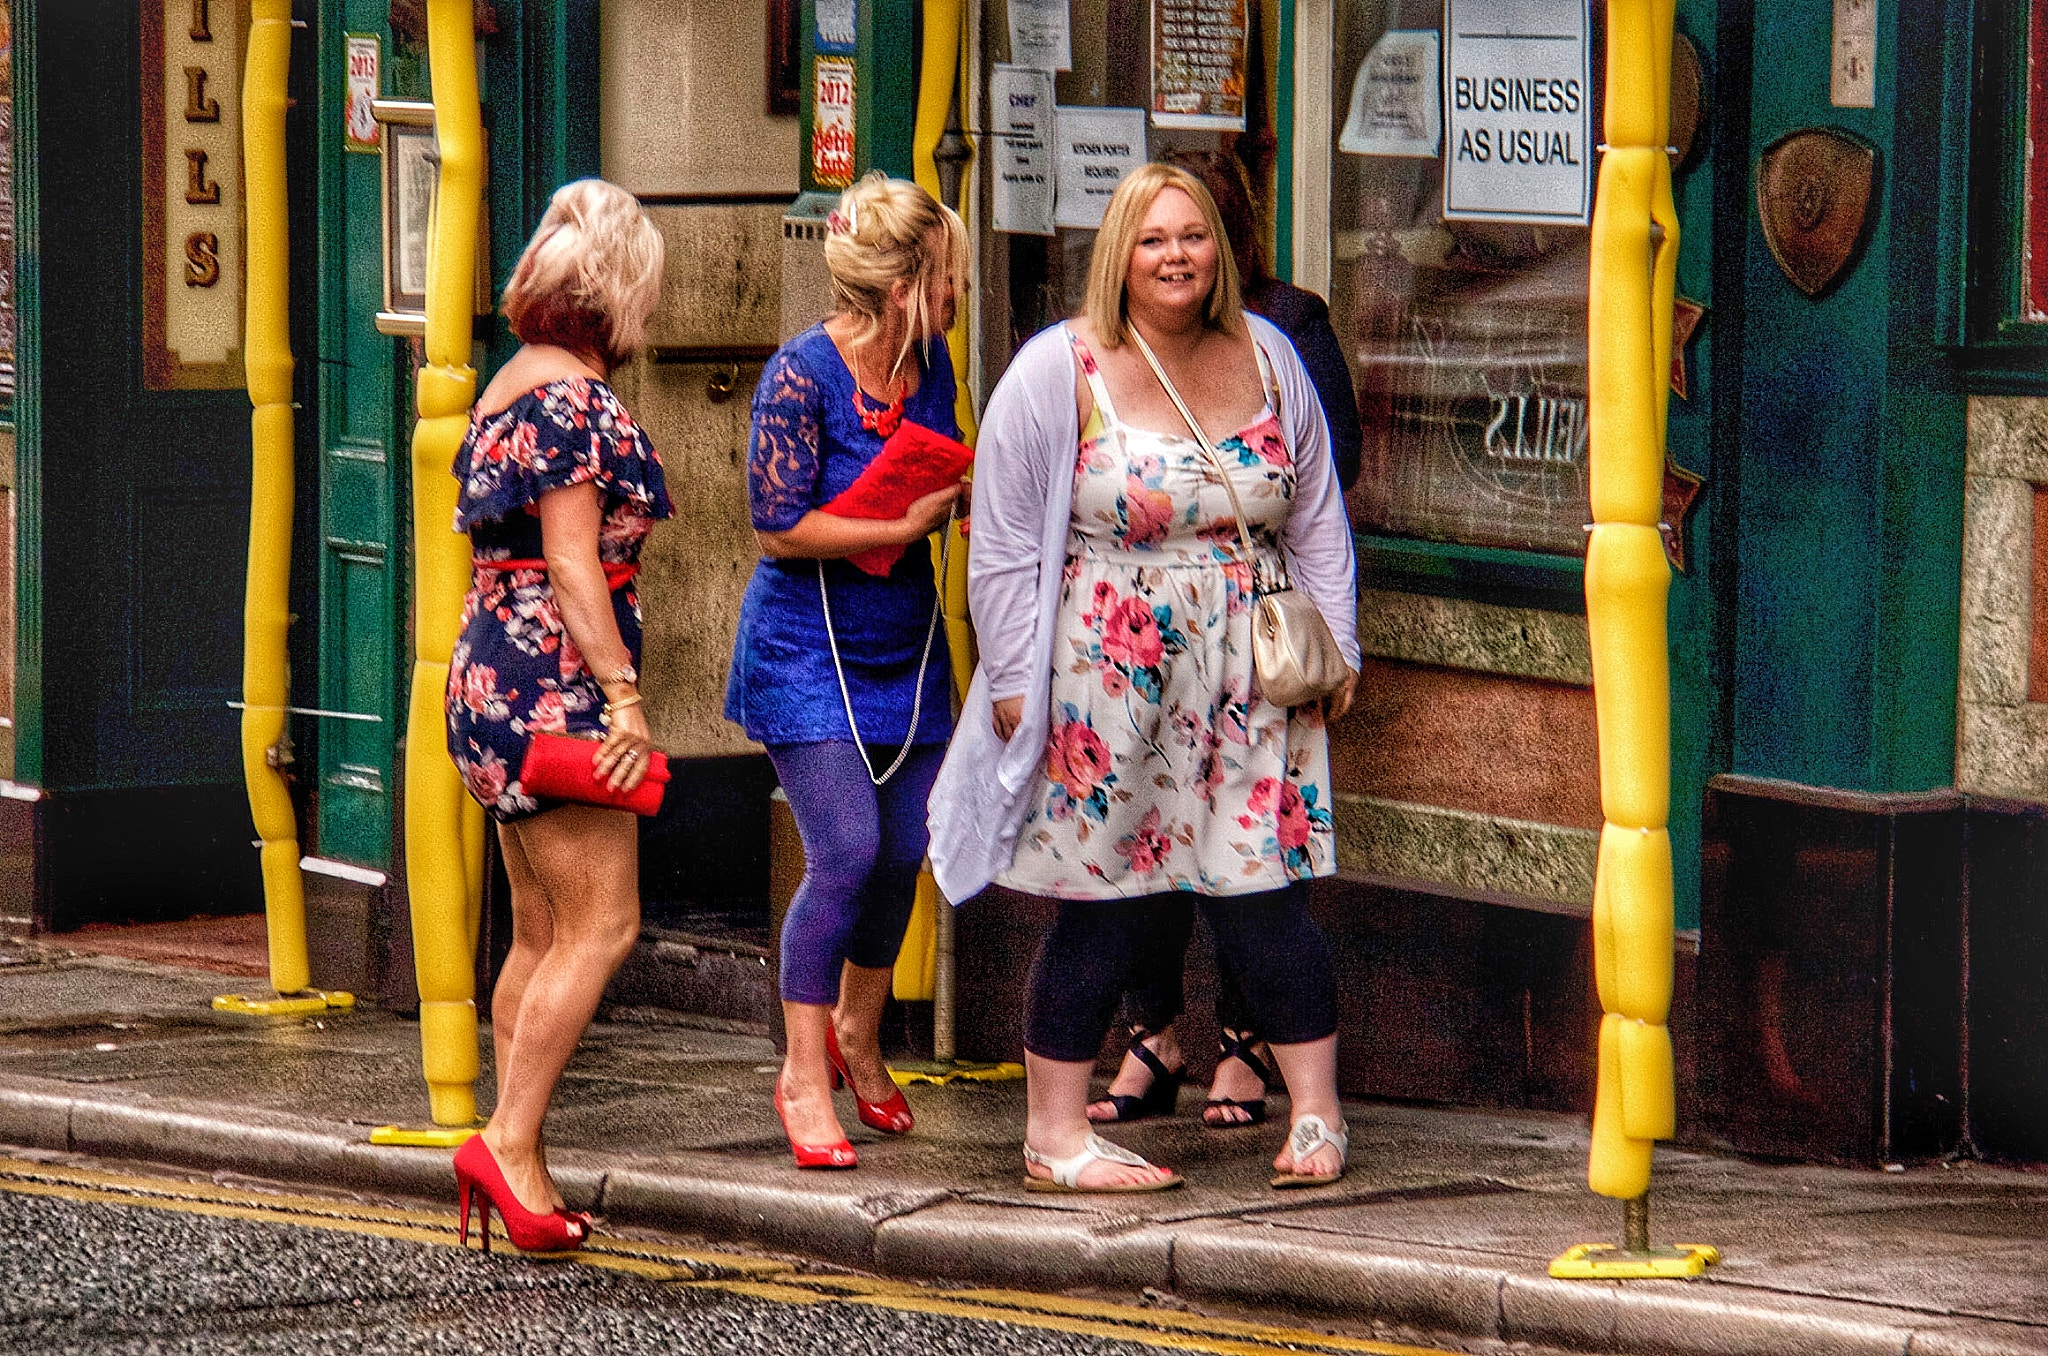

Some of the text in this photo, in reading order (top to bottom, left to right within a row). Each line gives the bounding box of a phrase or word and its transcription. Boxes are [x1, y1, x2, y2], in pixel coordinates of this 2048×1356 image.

[350, 55, 375, 77] 2013
[820, 81, 850, 105] 2012
[1008, 94, 1037, 108] CHEF
[1455, 76, 1580, 113] BUSINESS
[1072, 142, 1130, 156] KITCHEN PORTER
[1457, 128, 1580, 166] AS USUAL
[1084, 165, 1119, 179] REQUIRED
